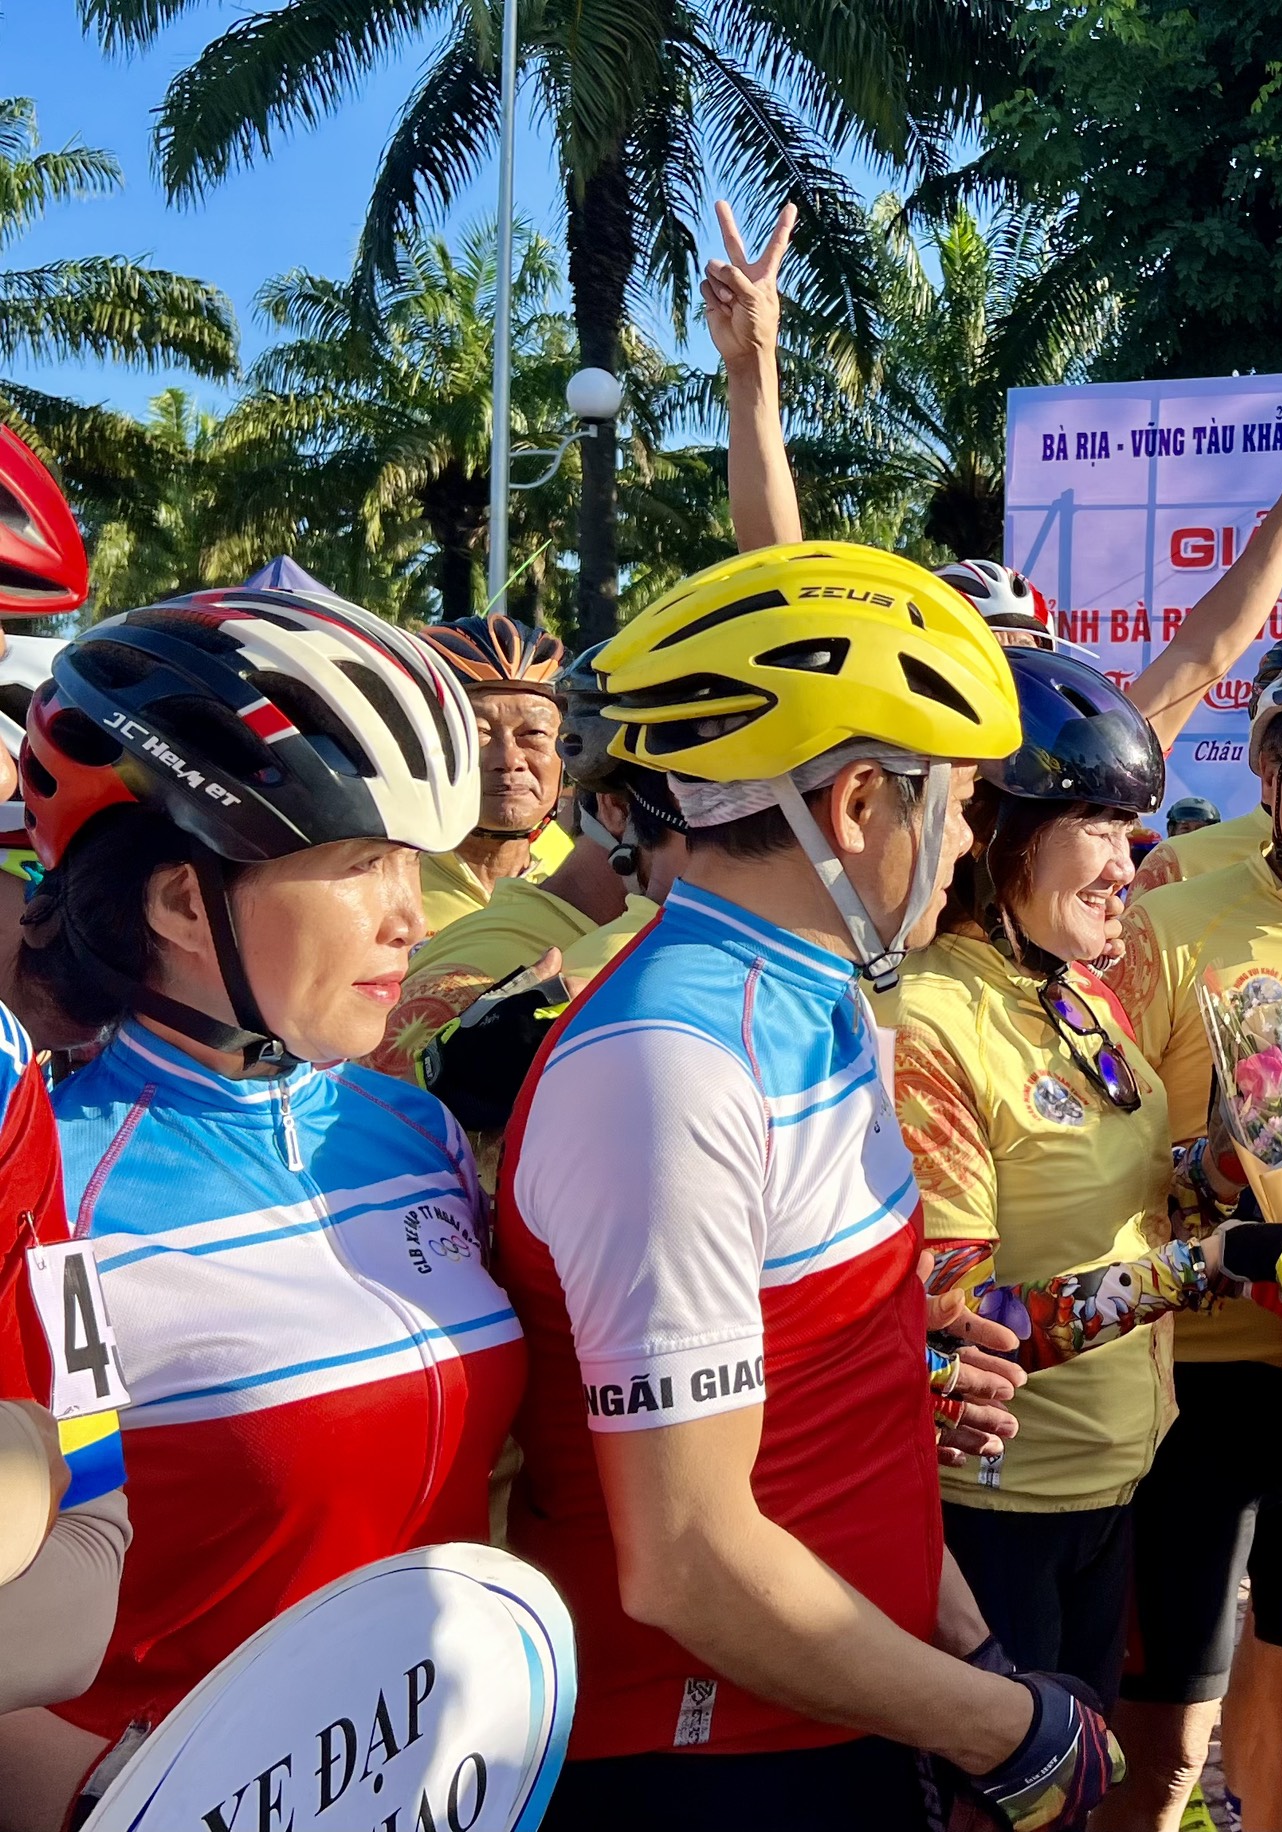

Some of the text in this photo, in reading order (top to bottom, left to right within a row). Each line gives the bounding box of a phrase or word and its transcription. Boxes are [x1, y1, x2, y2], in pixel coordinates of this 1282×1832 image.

[1042, 425, 1069, 461] BÀ
[1076, 431, 1111, 467] RỊA
[1131, 421, 1185, 458] VŨNG
[1193, 417, 1235, 456] TÀU
[798, 586, 896, 608] ZEUS
[1110, 601, 1152, 643] BÀ
[1195, 741, 1243, 761] Châu
[408, 1248, 432, 1274] CLB
[583, 1373, 675, 1417] NGÃI
[314, 1658, 436, 1817] ĐẠP
